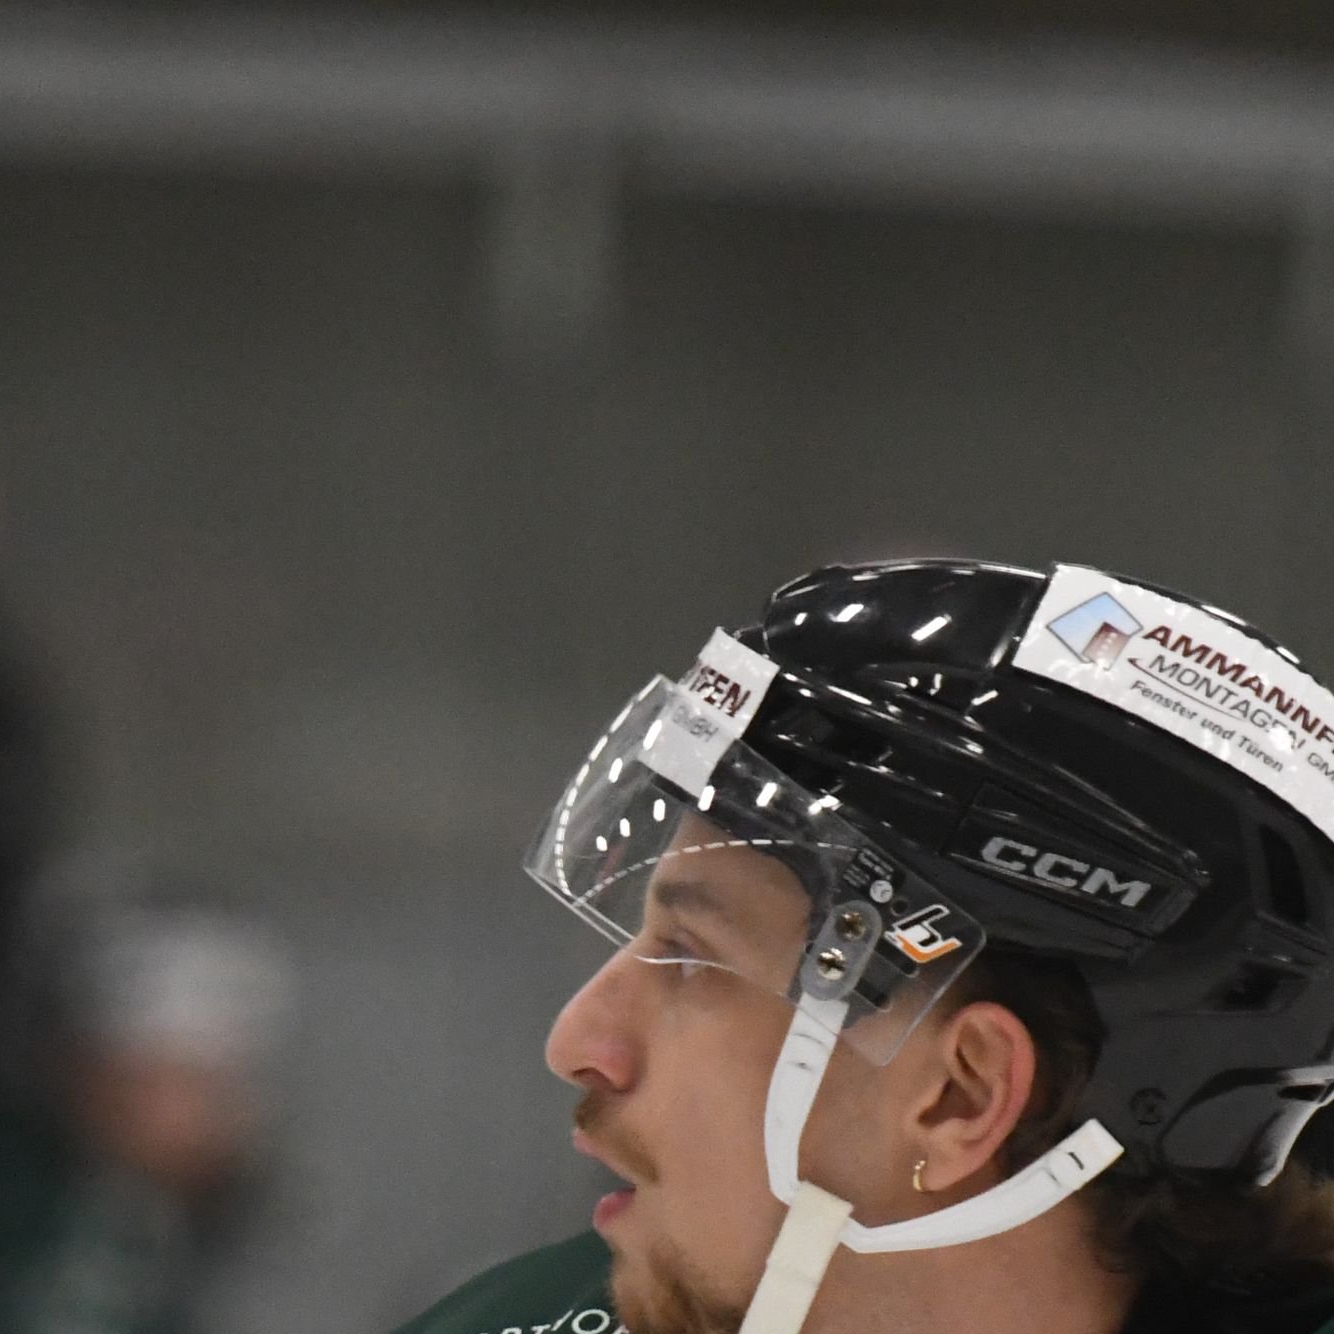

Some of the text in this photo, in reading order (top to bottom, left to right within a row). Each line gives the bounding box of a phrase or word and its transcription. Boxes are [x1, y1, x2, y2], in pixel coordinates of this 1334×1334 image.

[1130, 679, 1284, 773] Fenster und Türen
[980, 836, 1152, 907] CCM
